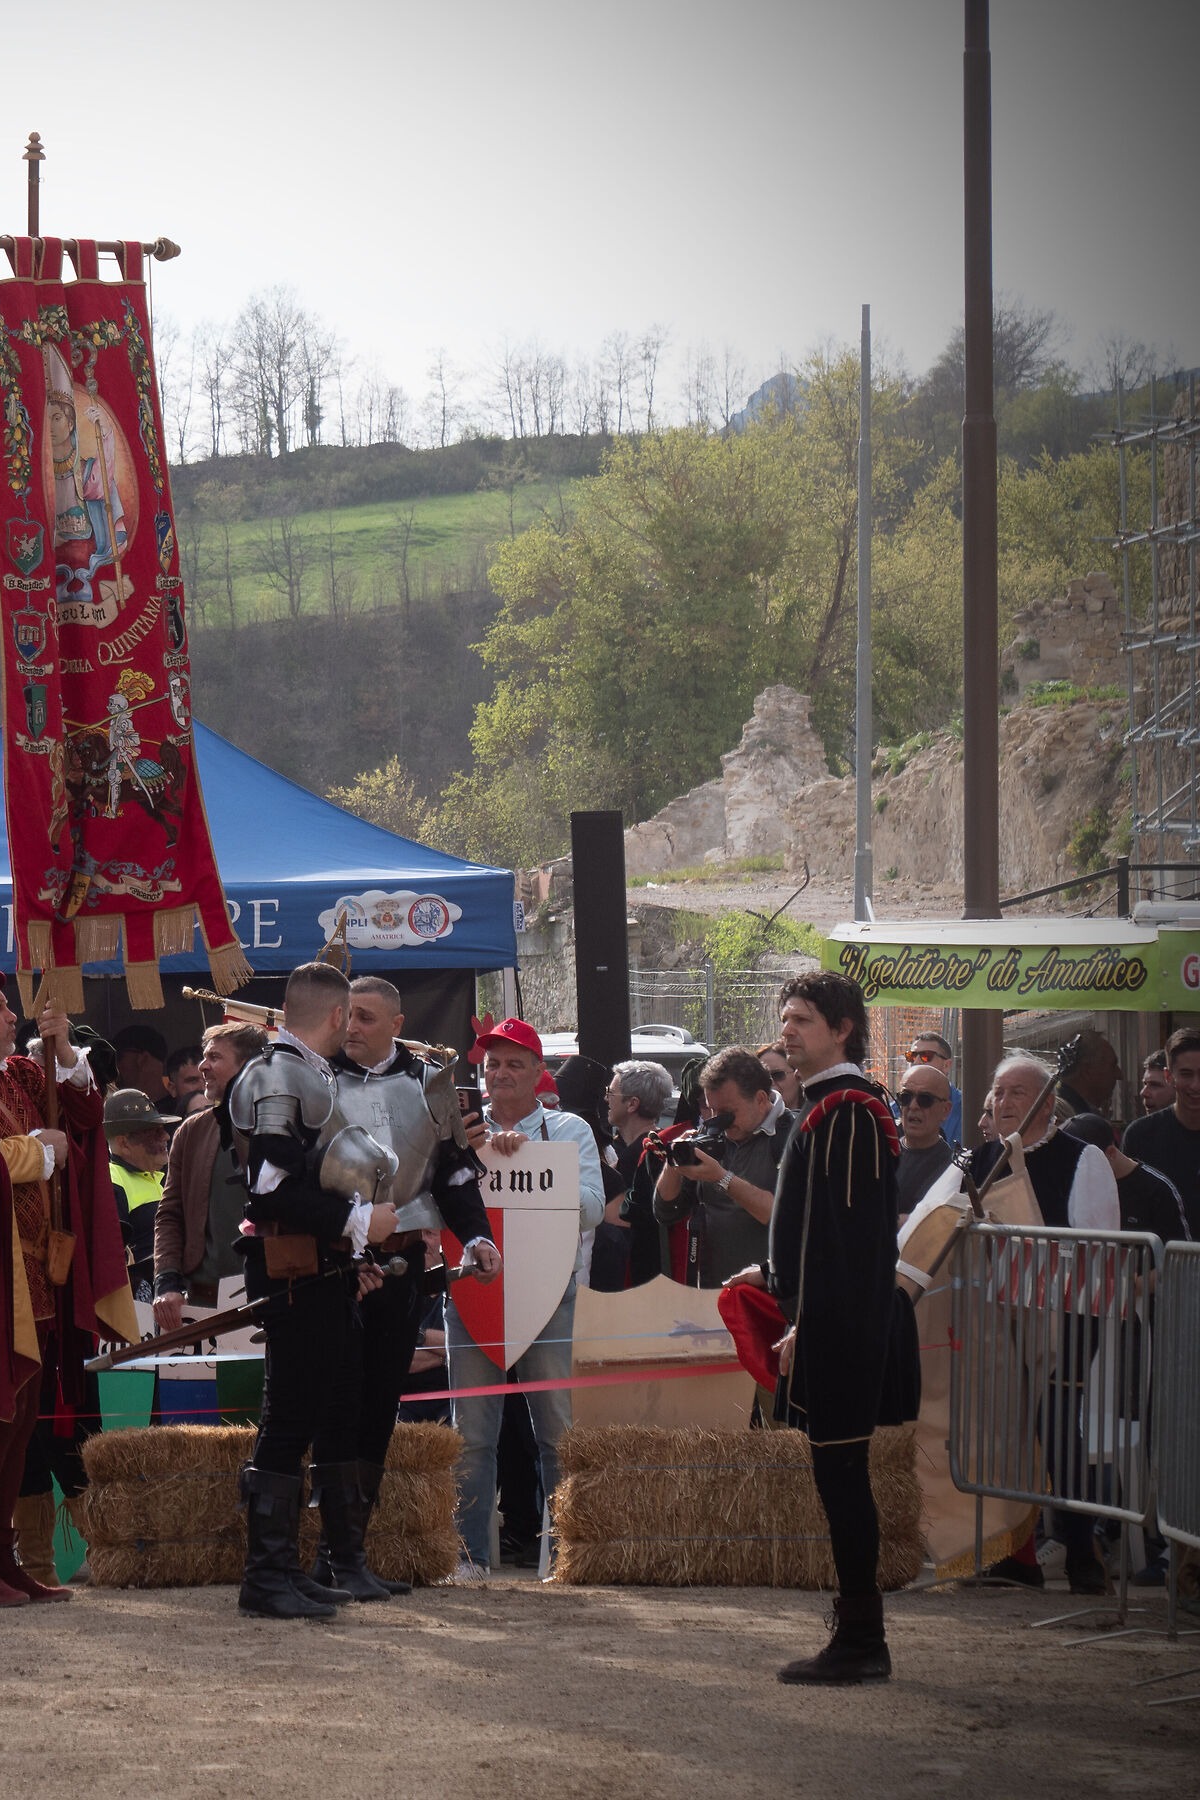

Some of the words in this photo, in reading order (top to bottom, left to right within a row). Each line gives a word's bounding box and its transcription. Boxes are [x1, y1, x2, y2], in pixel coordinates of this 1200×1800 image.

[98, 595, 161, 666] QUINTANA
[988, 949, 1023, 990] di
[1019, 947, 1147, 994] Amatrice
[478, 1167, 554, 1194] amo
[689, 1236, 698, 1263] Canon
